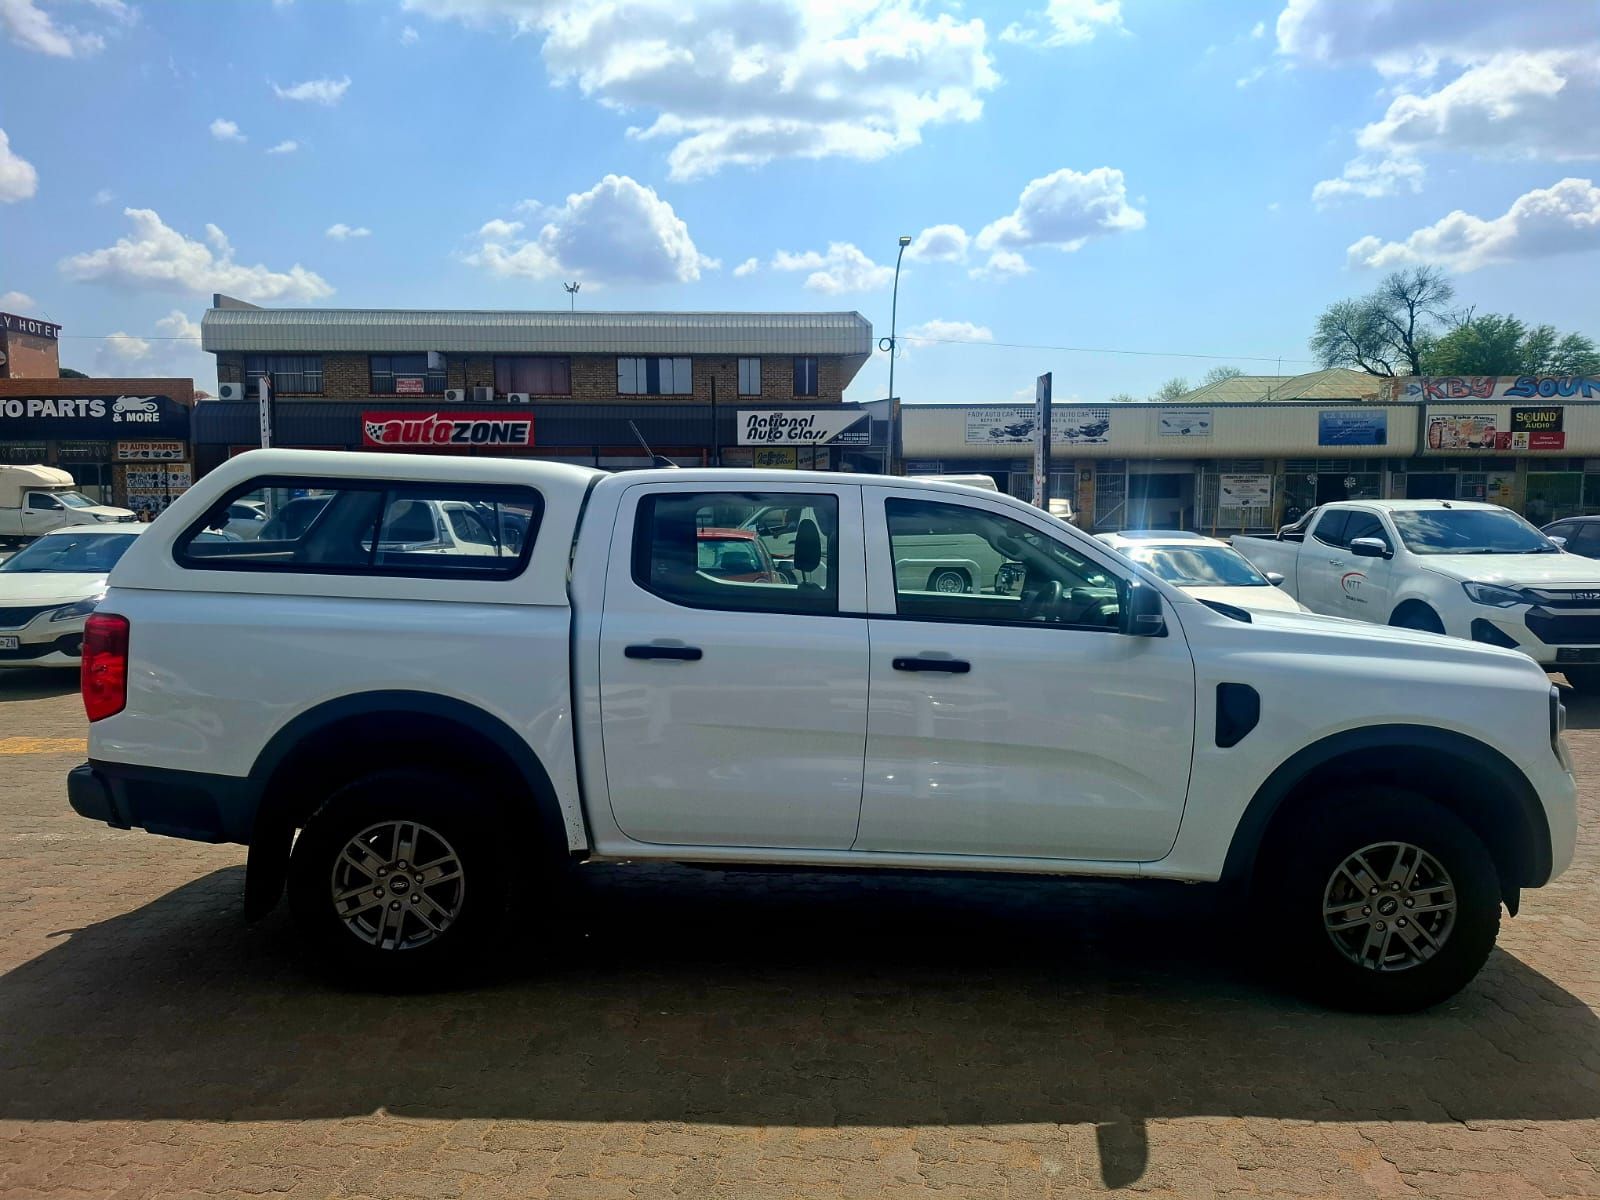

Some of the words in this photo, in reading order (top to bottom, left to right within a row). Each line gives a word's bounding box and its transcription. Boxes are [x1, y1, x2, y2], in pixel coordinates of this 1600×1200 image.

[19, 319, 59, 339] HOTEL
[1422, 376, 1498, 399] KBY
[27, 399, 106, 418] PARTS
[985, 410, 1001, 418] AUTO
[112, 413, 122, 423] &
[126, 413, 160, 422] MORE
[747, 413, 815, 428] National
[1516, 412, 1557, 423] SOUND
[747, 427, 783, 440] Auto
[787, 427, 828, 440] Glass
[1346, 579, 1362, 590] NTT
